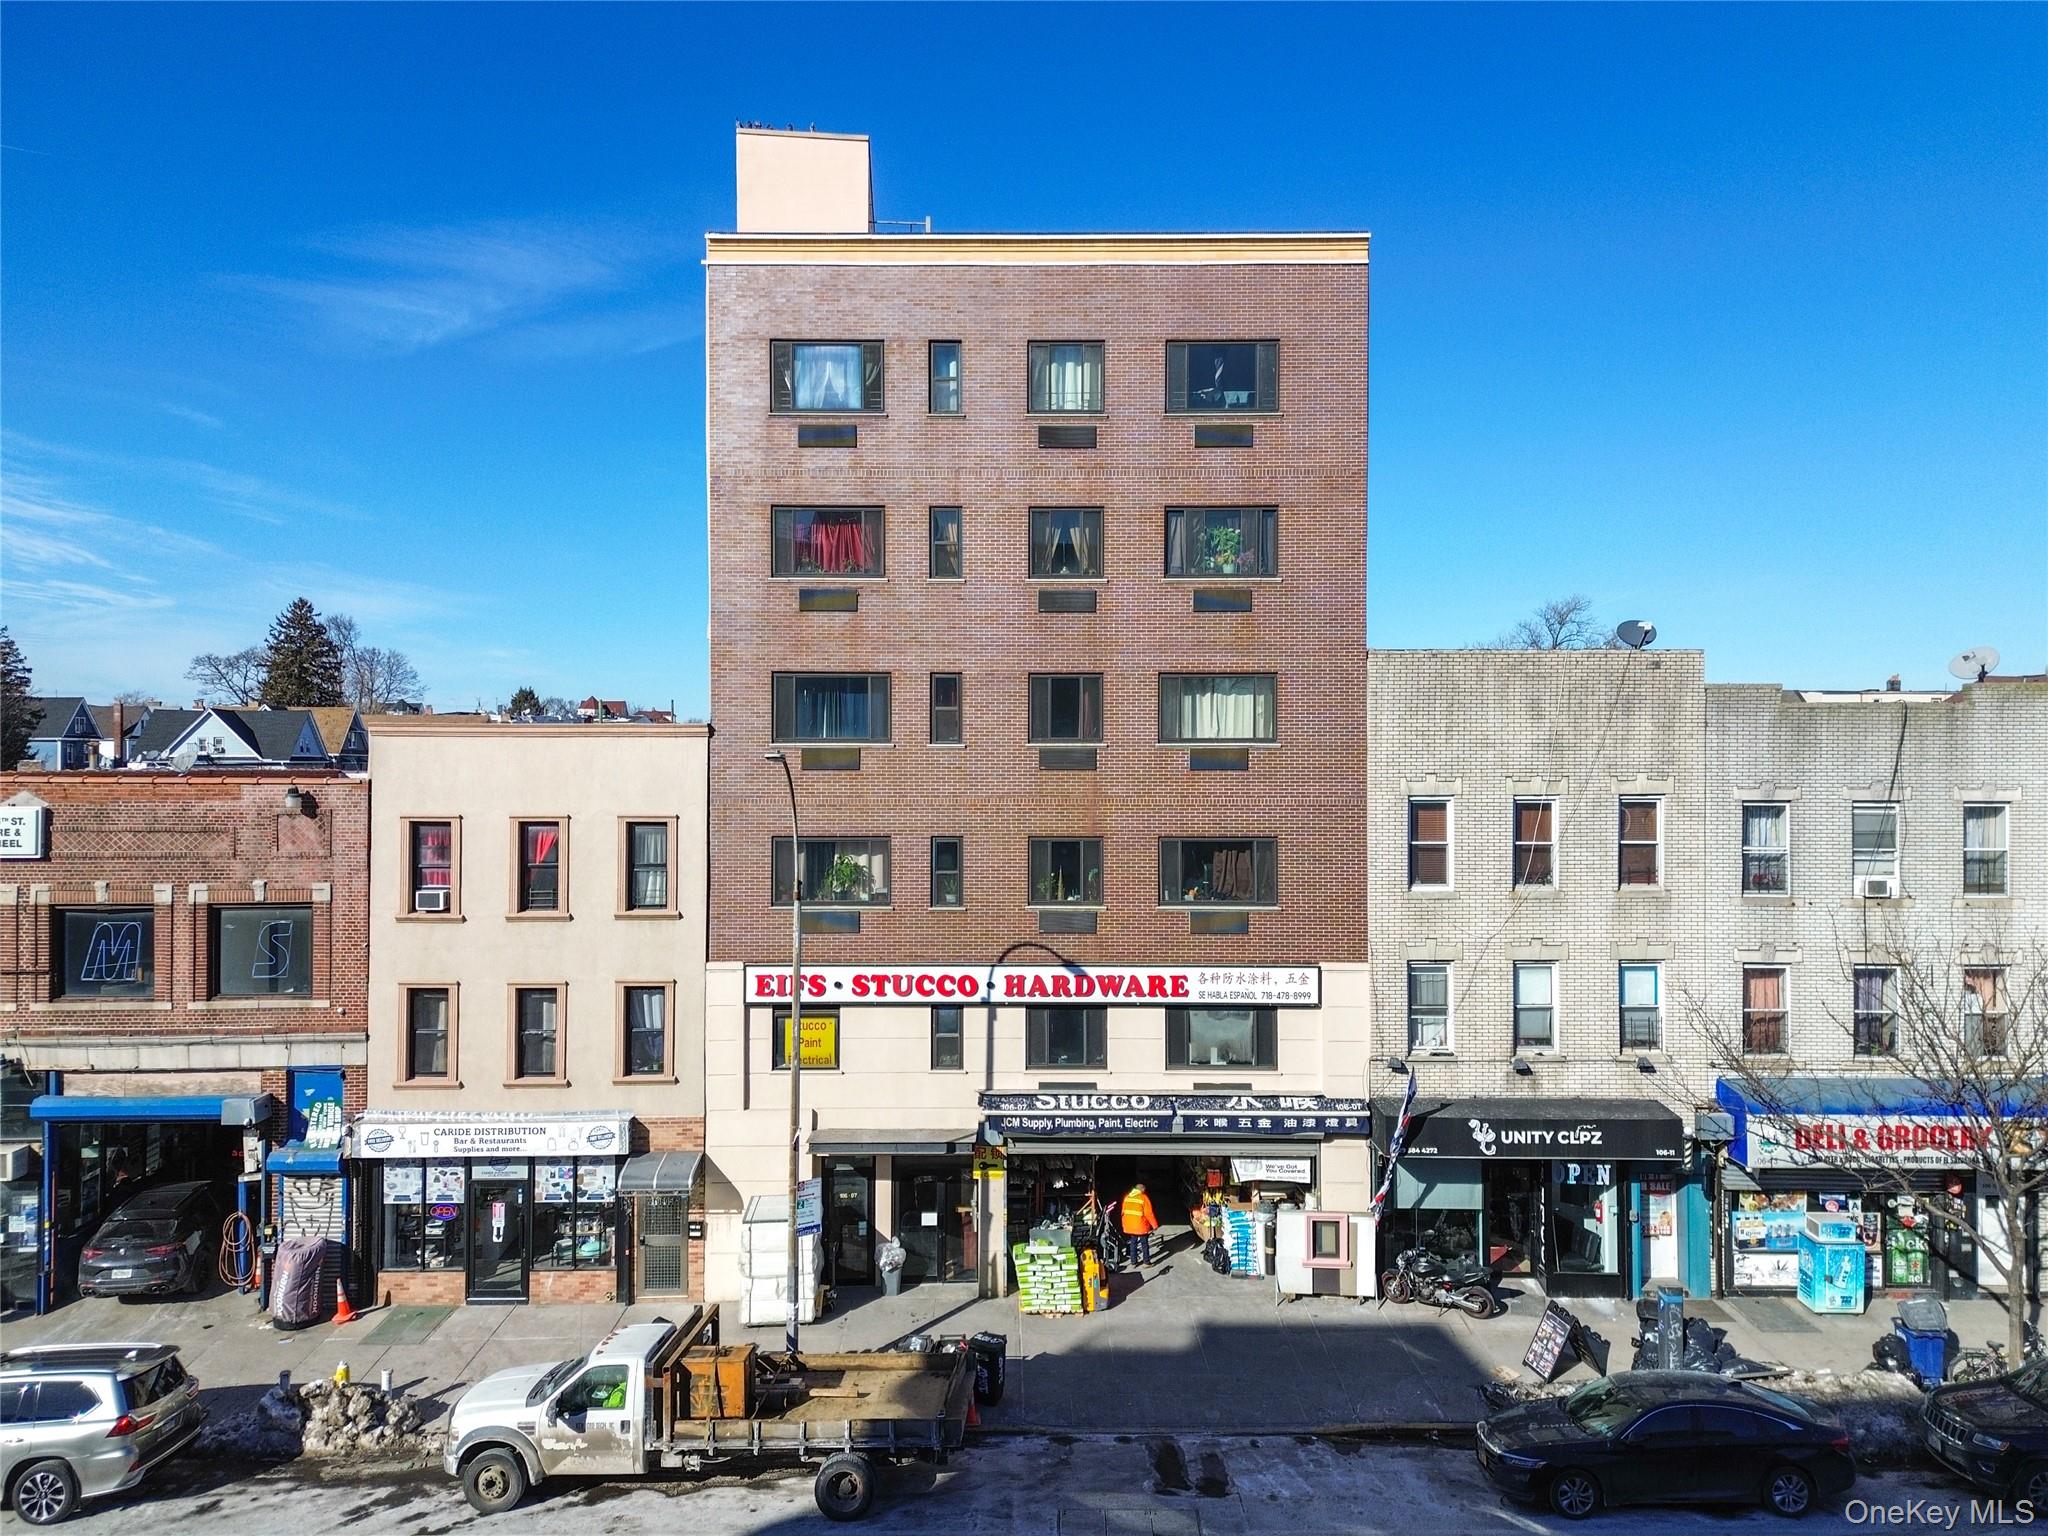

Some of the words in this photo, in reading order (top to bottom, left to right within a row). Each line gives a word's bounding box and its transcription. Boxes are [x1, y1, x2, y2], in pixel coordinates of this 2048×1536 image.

[11, 817, 26, 826] ST.
[14, 828, 21, 837] &
[0, 839, 23, 848] EEL
[252, 920, 293, 978] S
[851, 974, 979, 998] STUCCO
[1003, 974, 1190, 999] HARDWARE
[1198, 990, 1206, 1000] SE
[1207, 990, 1228, 1000] HABLA
[1229, 988, 1258, 1000] ESPAÑOL
[1261, 990, 1312, 1000] 718-478-8999
[799, 1020, 827, 1031] ucco
[1036, 1094, 1150, 1110] Stucco
[1022, 1117, 1053, 1131] Supply,
[1055, 1117, 1096, 1130] Plumbing,
[1099, 1117, 1123, 1129] Paint,
[1125, 1117, 1159, 1128] Electric
[433, 1127, 472, 1136] CARIDE
[474, 1127, 547, 1136] DISTRIBUTION
[478, 1137, 527, 1145] Restaurants
[1501, 1130, 1554, 1144] UNITY
[1794, 1123, 1847, 1151] DELI
[1853, 1128, 1870, 1150] &
[1877, 1123, 1994, 1152] GROCERY
[453, 1146, 484, 1154] Supplies
[1903, 1156, 1935, 1164] PRODUCTS
[1552, 1163, 1611, 1186] OPEN
[1851, 1201, 1858, 1210] A
[430, 1206, 457, 1216] OPEN
